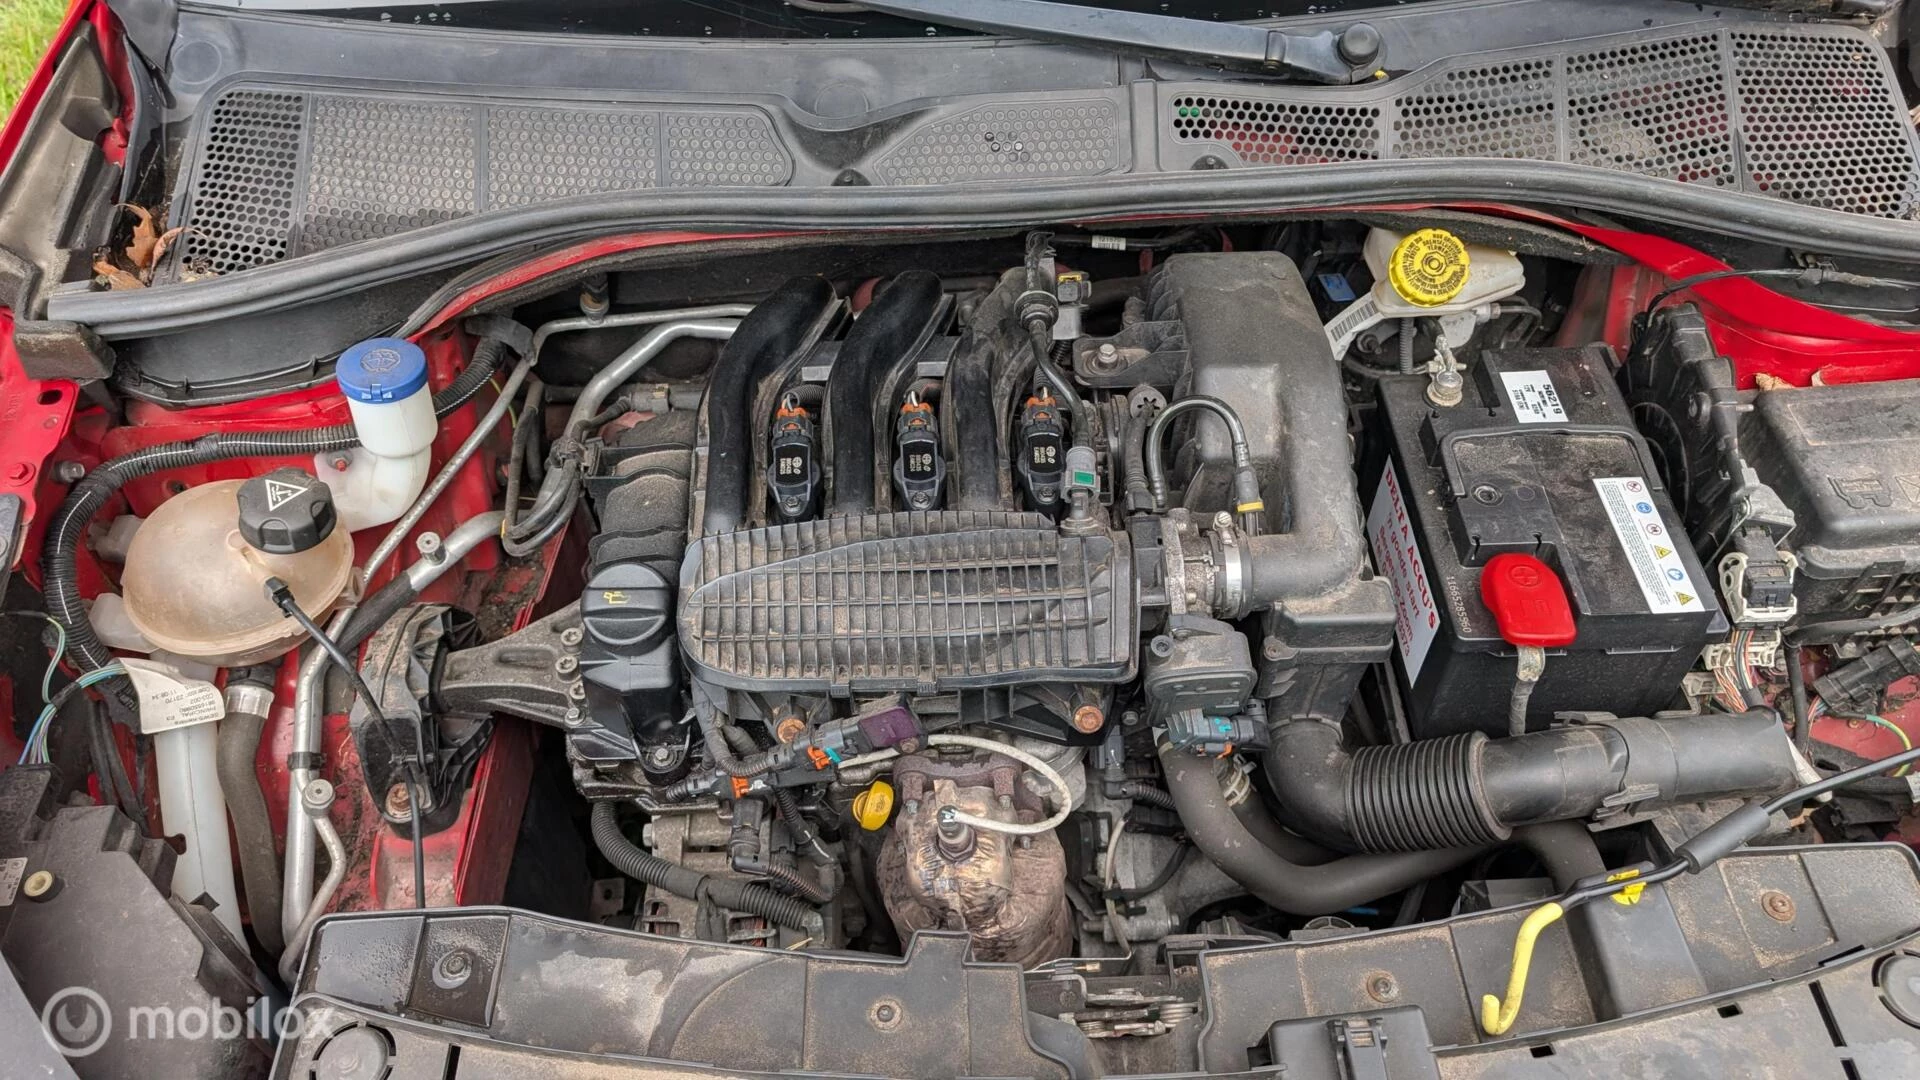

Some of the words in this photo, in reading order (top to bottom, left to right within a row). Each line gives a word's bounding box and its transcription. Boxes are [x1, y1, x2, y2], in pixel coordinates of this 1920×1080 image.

[1543, 384, 1562, 414] 56219
[1385, 468, 1408, 542] DELTA
[1408, 545, 1436, 630] ACCU'S
[1391, 531, 1407, 577] goede
[1406, 581, 1420, 618] start
[1400, 598, 1413, 641] Zoom
